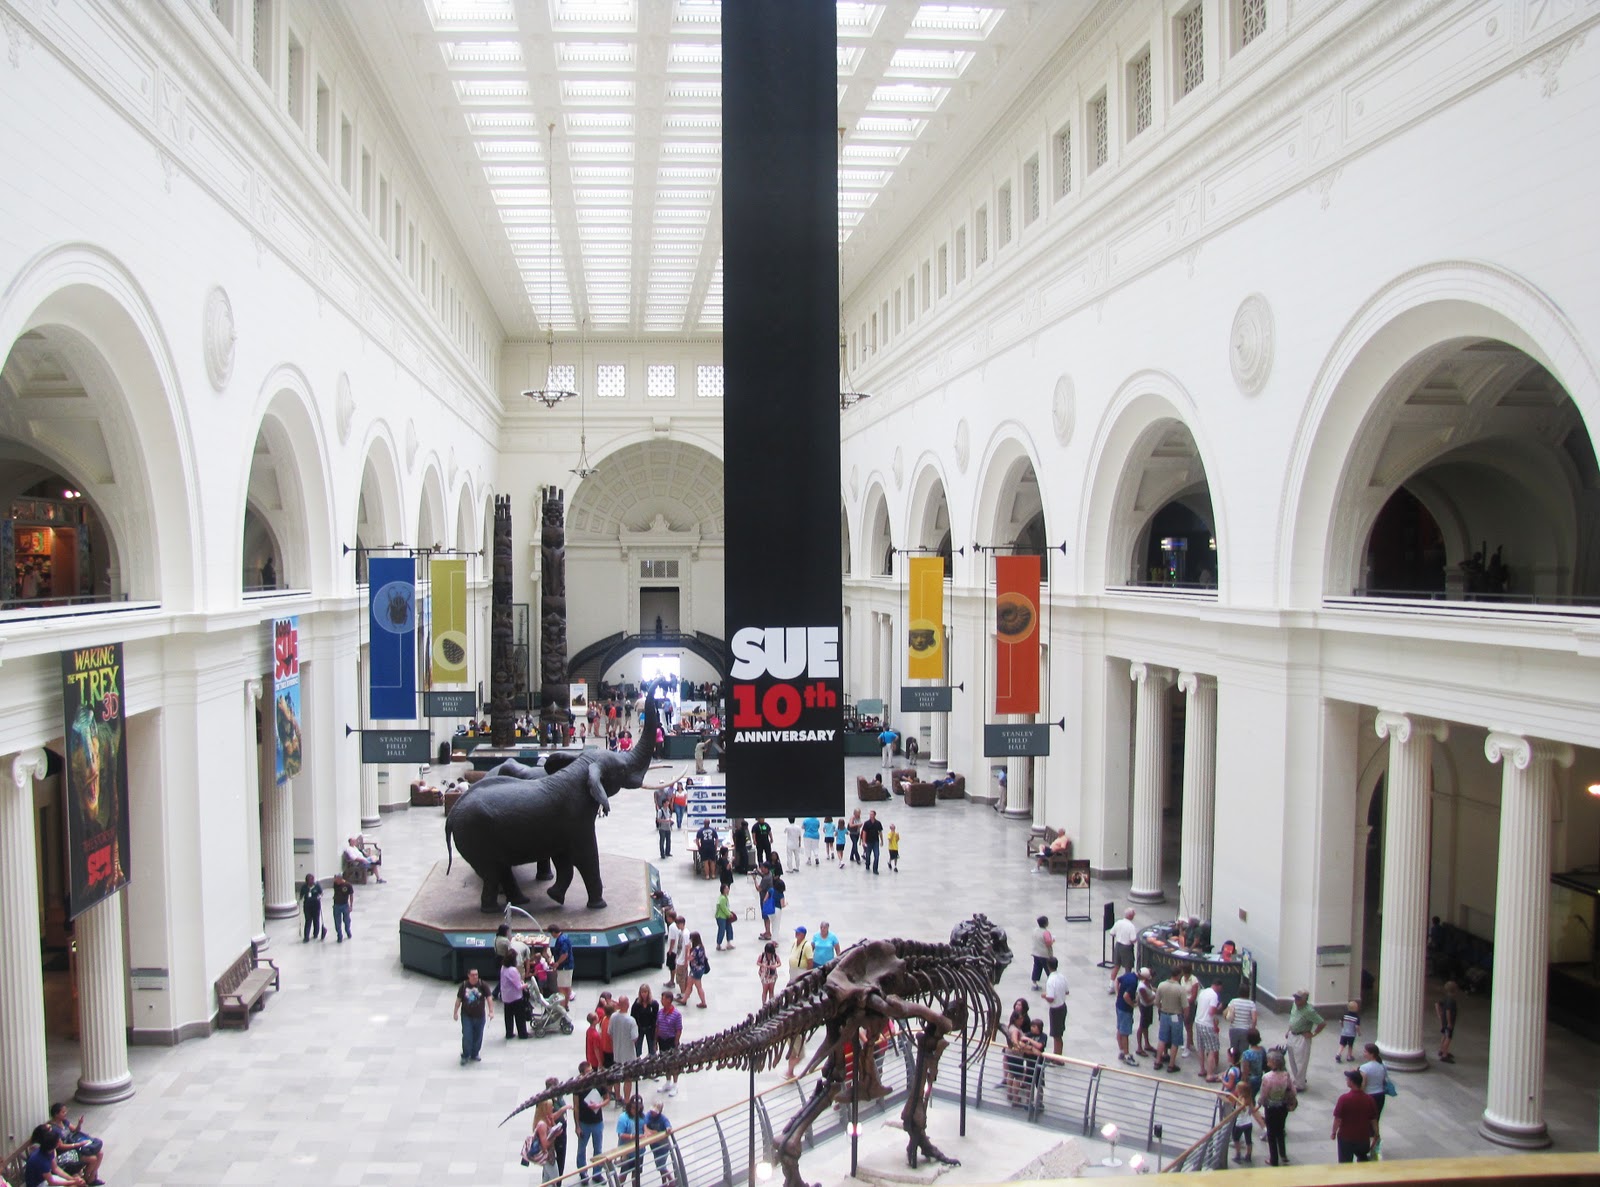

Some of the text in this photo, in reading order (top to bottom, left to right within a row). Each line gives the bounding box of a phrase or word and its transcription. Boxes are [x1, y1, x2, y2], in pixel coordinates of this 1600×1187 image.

[74, 645, 115, 671] WAKING
[730, 626, 840, 681] SUE
[102, 691, 119, 722] 3D
[733, 682, 837, 728] 10th
[734, 730, 836, 743] ANNIVERSARY
[1152, 952, 1241, 975] INFORATION
